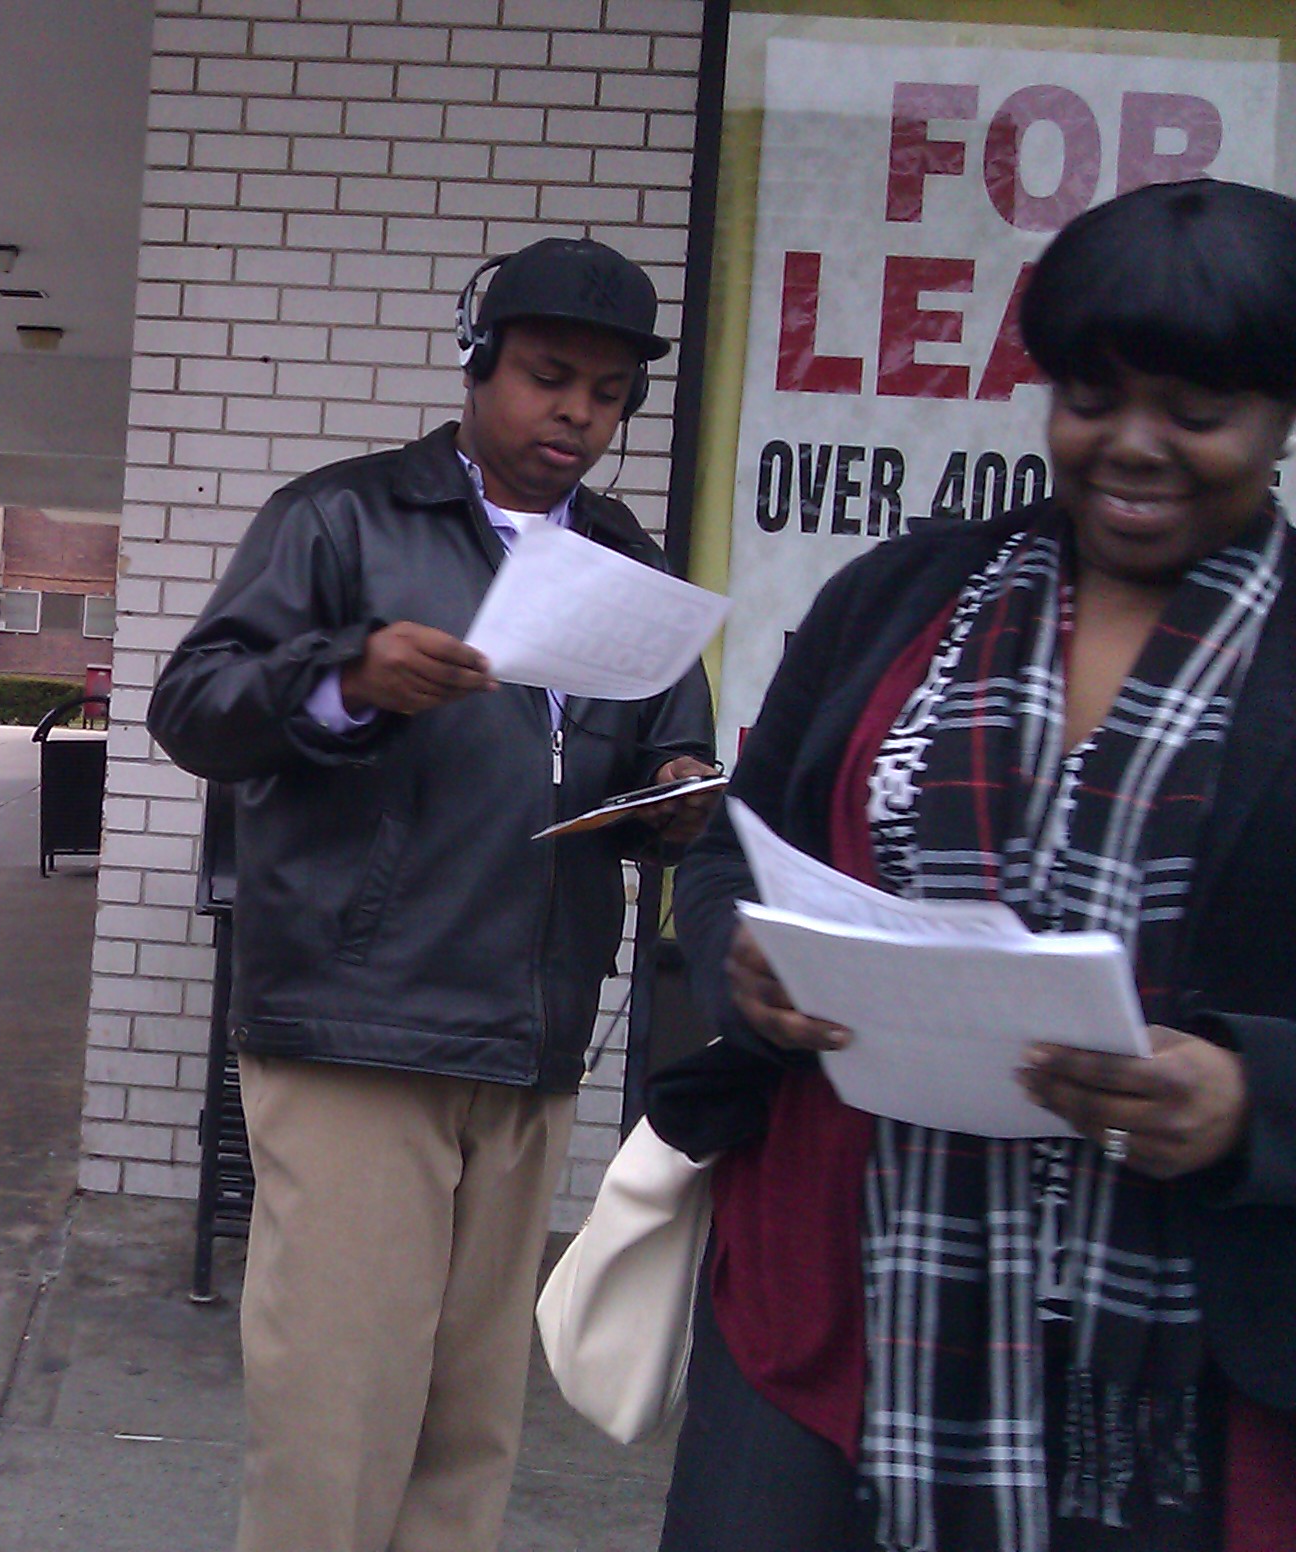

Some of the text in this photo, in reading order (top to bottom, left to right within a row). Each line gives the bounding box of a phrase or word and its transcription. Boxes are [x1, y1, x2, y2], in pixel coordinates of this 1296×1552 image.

[885, 81, 1223, 233] FOR
[775, 251, 1049, 402] LEA
[757, 439, 905, 537] OVER
